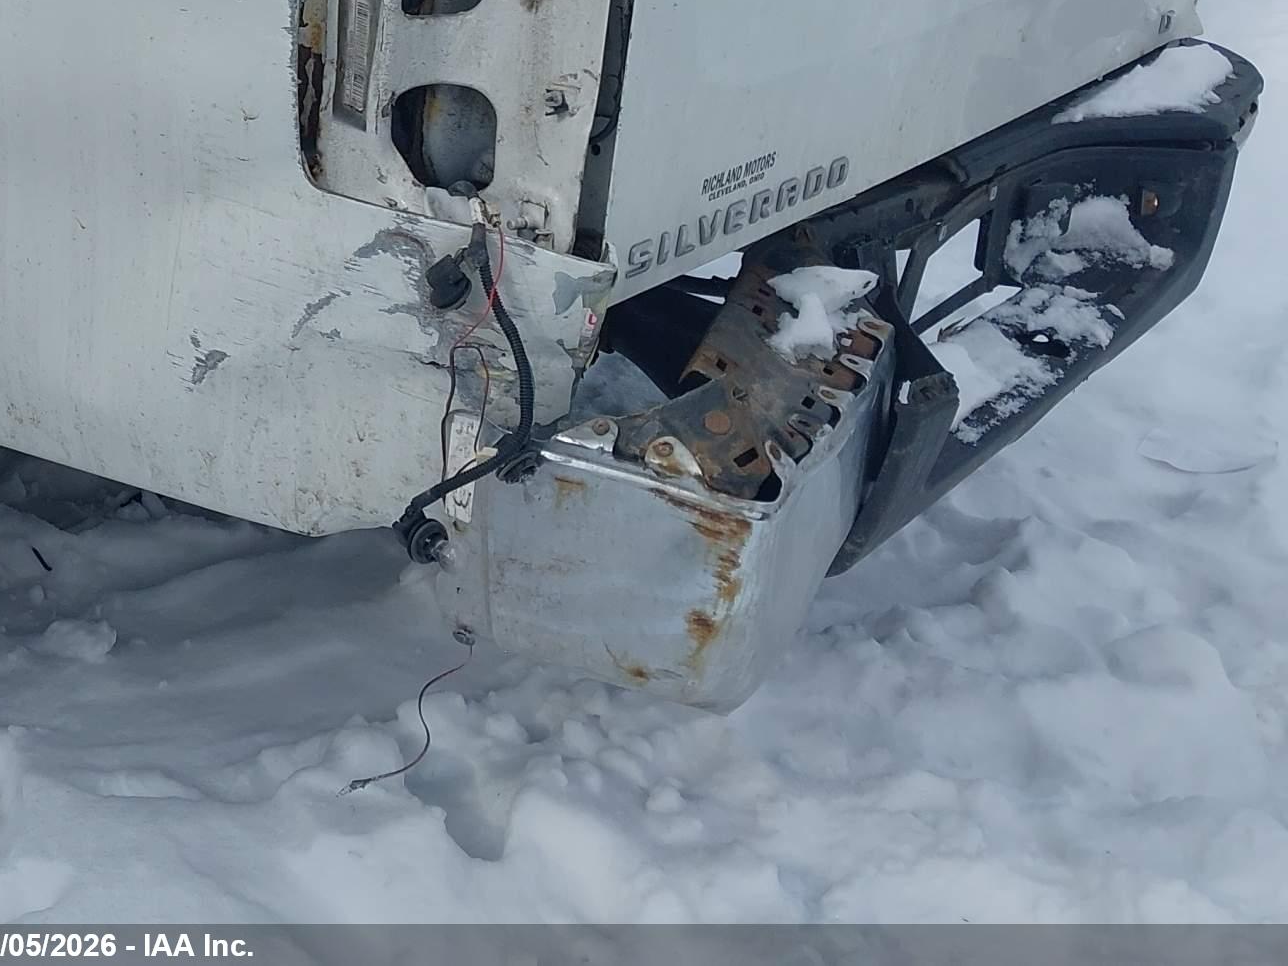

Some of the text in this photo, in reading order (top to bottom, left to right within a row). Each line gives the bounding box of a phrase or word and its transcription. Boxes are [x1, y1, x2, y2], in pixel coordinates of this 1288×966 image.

[701, 151, 776, 195] RICHLAND MOTORS
[625, 156, 850, 279] SILVERADO
